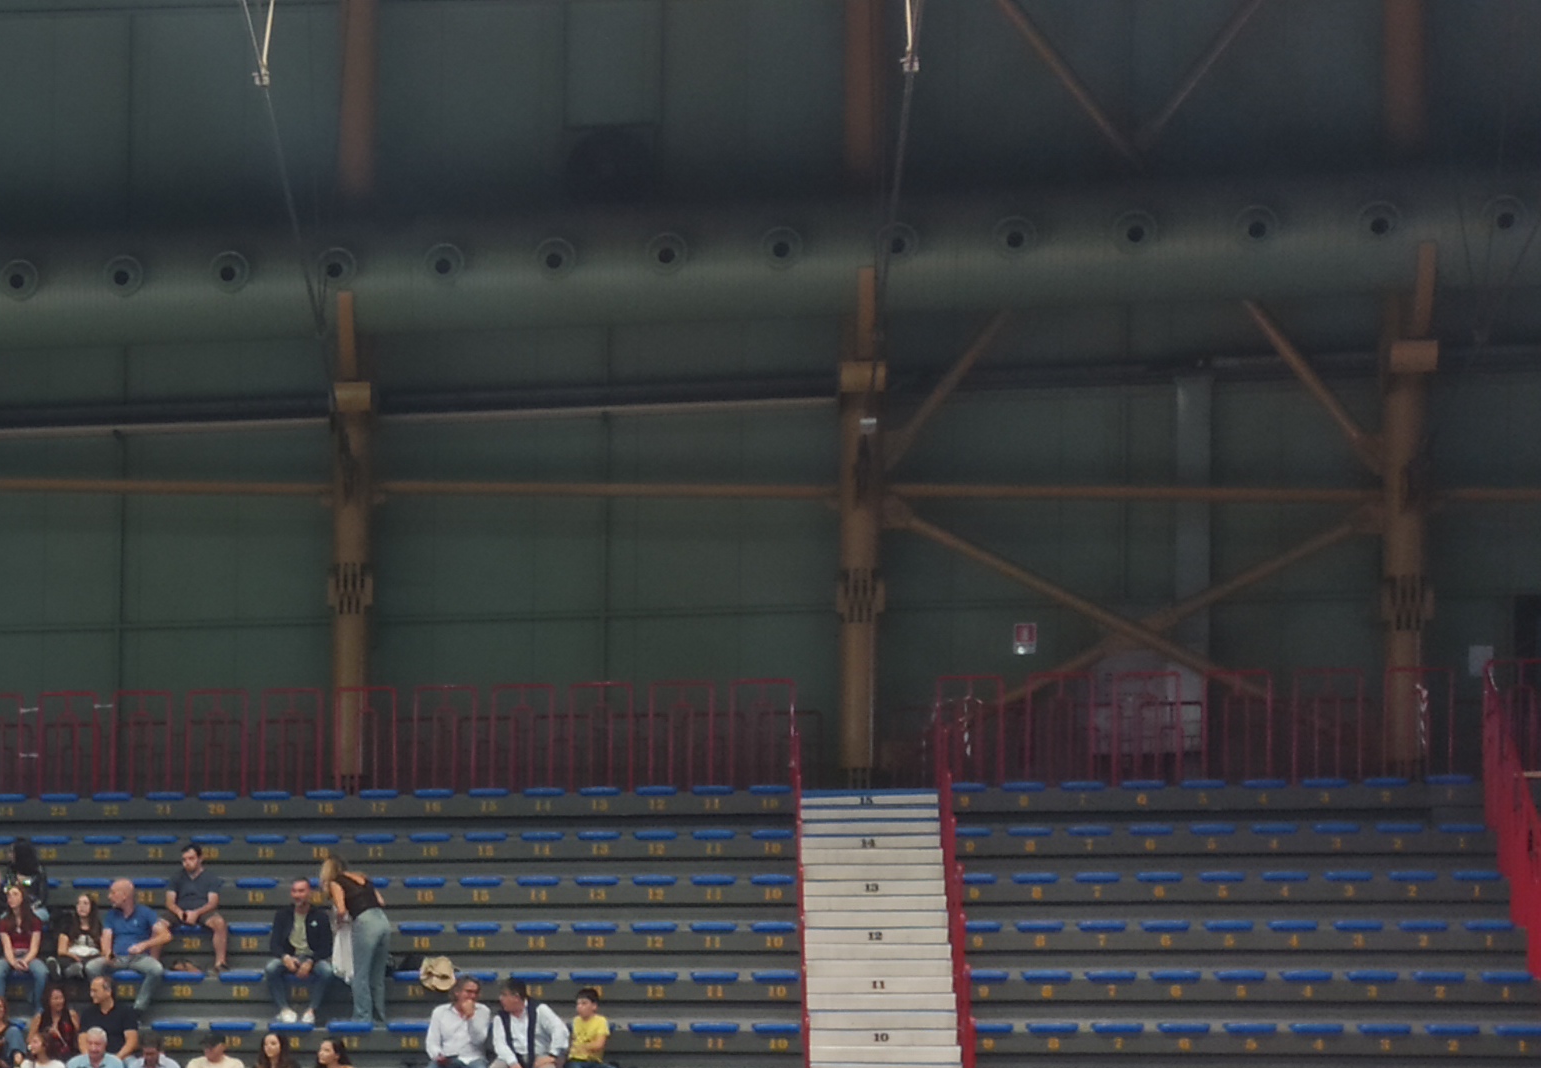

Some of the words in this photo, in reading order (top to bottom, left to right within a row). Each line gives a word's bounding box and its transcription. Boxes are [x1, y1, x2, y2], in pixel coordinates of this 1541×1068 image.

[859, 797, 874, 806] 15
[860, 838, 876, 848] 14
[865, 883, 879, 892] 13
[868, 931, 883, 941] 12
[872, 980, 885, 990] 11
[874, 1032, 890, 1042] 10
